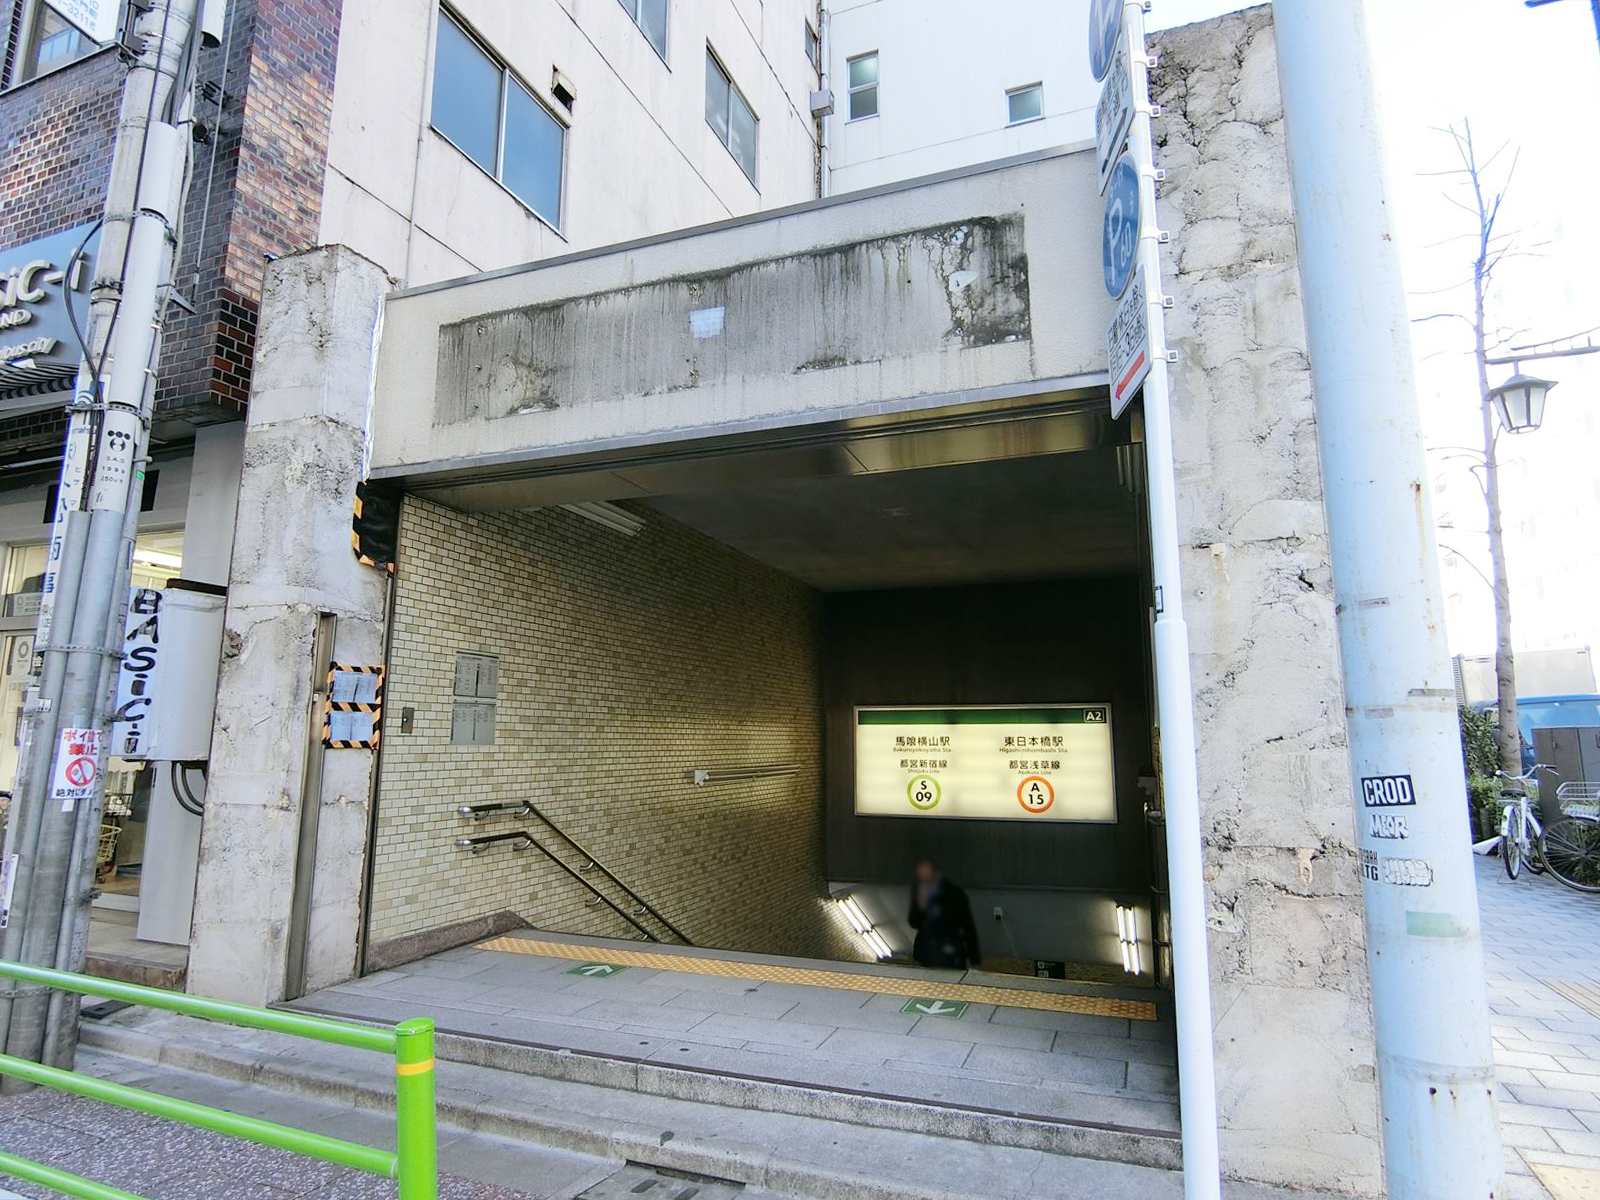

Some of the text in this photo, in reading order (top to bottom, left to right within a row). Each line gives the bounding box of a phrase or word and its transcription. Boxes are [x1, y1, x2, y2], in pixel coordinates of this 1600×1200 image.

[1109, 197, 1123, 287] P
[1120, 221, 1131, 269] 60
[1086, 711, 1102, 721] A2
[895, 736, 950, 746] 馬喰横山駅
[1004, 736, 1064, 747] 東日本橋駅
[900, 759, 948, 768] 都営新宿線
[1009, 760, 1061, 770] 都営浅草線
[920, 780, 928, 790] S
[1030, 783, 1040, 792] A
[1363, 777, 1412, 805] CROD
[915, 791, 933, 802] 09
[1028, 794, 1044, 805] 15
